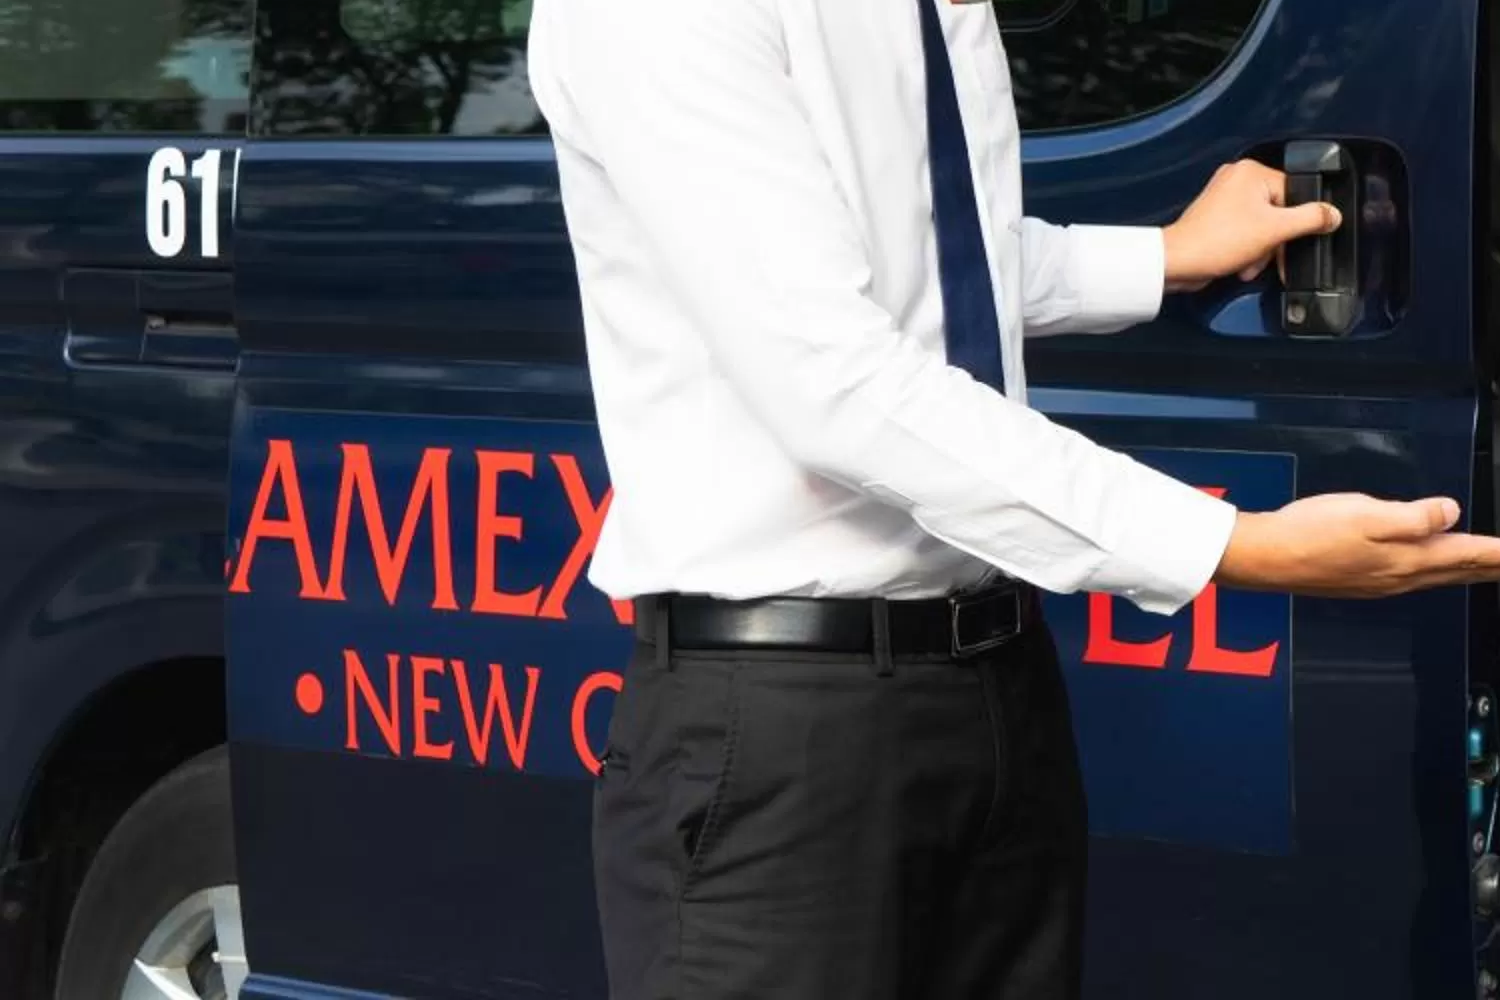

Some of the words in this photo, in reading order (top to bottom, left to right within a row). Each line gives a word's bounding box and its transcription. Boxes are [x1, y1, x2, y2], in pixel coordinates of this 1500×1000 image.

[146, 146, 242, 257] 61
[223, 439, 635, 625] AMEX
[343, 649, 540, 770] NEW
